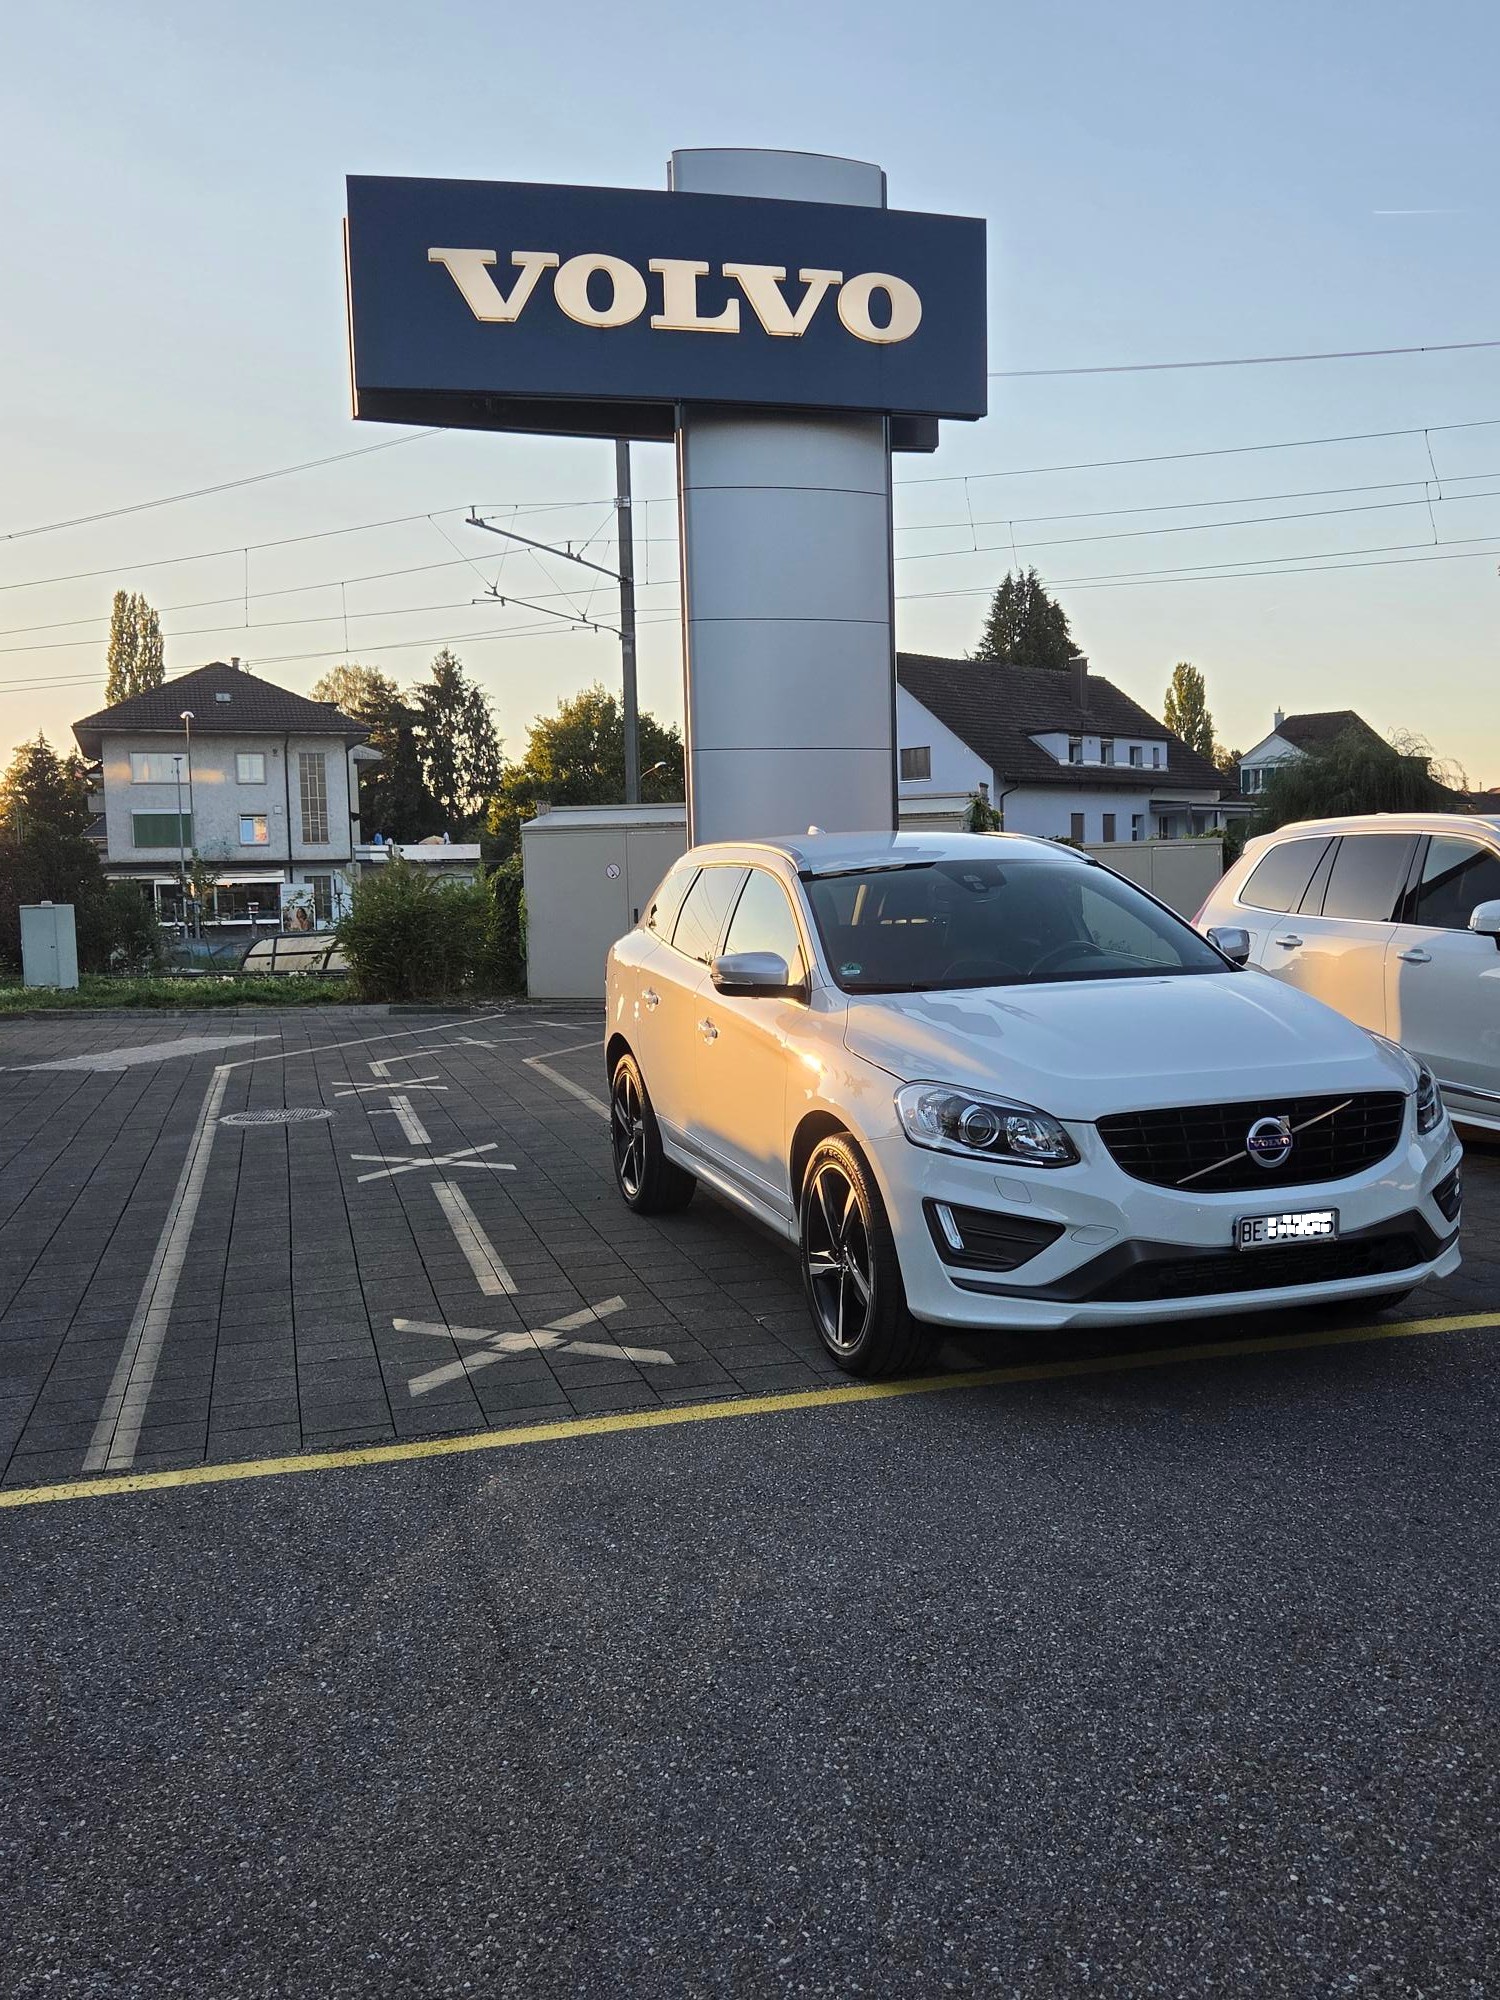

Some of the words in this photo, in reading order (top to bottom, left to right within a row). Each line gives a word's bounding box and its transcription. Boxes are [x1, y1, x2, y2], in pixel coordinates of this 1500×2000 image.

[427, 246, 923, 345] VOLVO
[1250, 1137, 1290, 1148] VOLVO
[1242, 1221, 1263, 1242] BE
